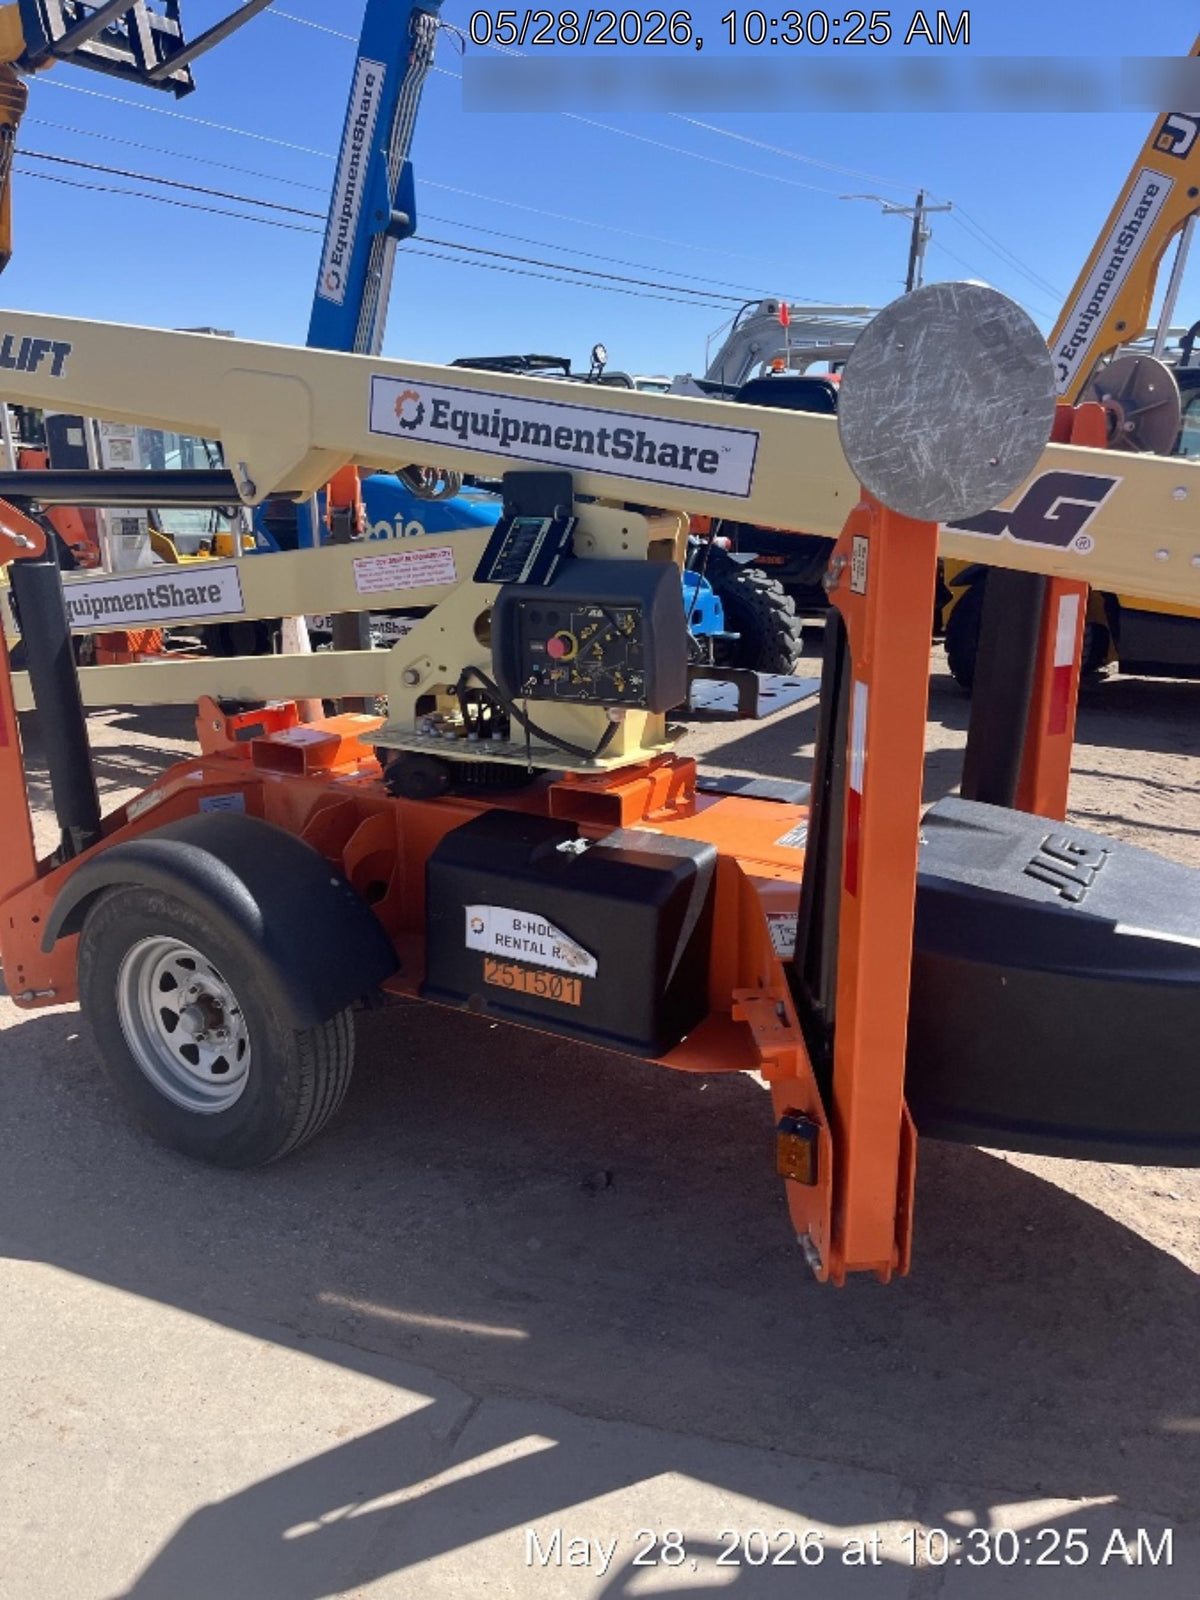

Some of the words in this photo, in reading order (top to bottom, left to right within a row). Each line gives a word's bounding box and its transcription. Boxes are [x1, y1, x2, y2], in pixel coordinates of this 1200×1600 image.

[331, 71, 376, 266] EquipmentShare
[1060, 183, 1160, 363] EquipmentShare
[0, 333, 73, 377] LIFT
[429, 397, 720, 475] EquipmentShare
[65, 583, 222, 623] quipmentShare
[495, 932, 547, 956] RENTAL
[512, 918, 555, 939] B-HOL
[486, 960, 577, 1003] 251501
